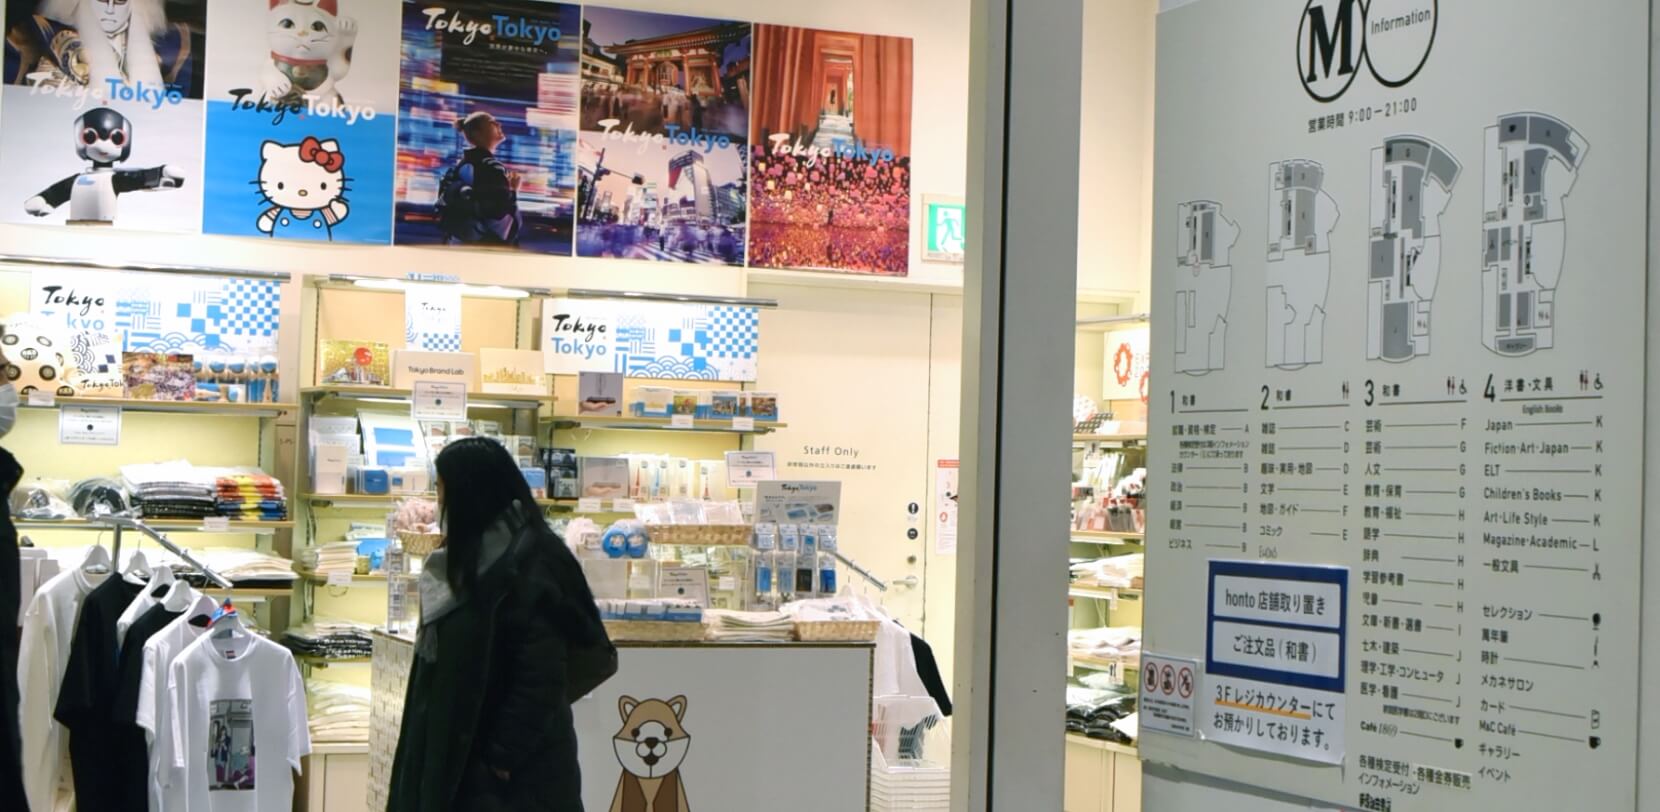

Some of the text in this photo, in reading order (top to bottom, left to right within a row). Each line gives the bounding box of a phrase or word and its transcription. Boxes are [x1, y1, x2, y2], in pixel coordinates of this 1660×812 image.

[422, 8, 561, 45] Tokyo Tokyo
[1371, 9, 1430, 34] Information
[1307, 0, 1354, 83] M
[105, 78, 182, 109] Tokyo
[228, 88, 376, 126] Tokyo Tokyo
[1308, 112, 1344, 133] 営業時間
[598, 118, 730, 155] Tokyo Tokyo
[768, 132, 894, 168] Tokyo Tokyo
[42, 285, 104, 316] Tokyo
[552, 314, 606, 342] Tokyo
[551, 337, 607, 360] Tokyo
[1364, 379, 1374, 407] 3
[1484, 374, 1496, 402] 4
[1170, 390, 1175, 414] 1
[1260, 385, 1270, 410] 2
[1366, 418, 1467, 432] 芸術 F
[1485, 416, 1603, 433] Japan K
[803, 445, 860, 458] Staff Only
[1365, 441, 1466, 454] 芸術 G
[1596, 440, 1603, 453] K
[1365, 462, 1466, 475] 人文 G
[1484, 464, 1602, 476] ELT K
[1260, 483, 1348, 496] 文学 E
[1459, 486, 1465, 498] G
[1484, 487, 1602, 502] Children's Books K
[1459, 509, 1464, 520] H
[1524, 512, 1548, 527] Style
[1593, 514, 1600, 527] K
[1260, 525, 1348, 541] コミック E
[1458, 532, 1464, 544] H
[1593, 537, 1599, 552] L
[1458, 555, 1464, 567] H
[1363, 571, 1464, 590] 学習参考書 H
[1225, 589, 1325, 616] honto 店舗取り置き
[1457, 601, 1463, 613] H
[1483, 604, 1533, 621] セレクション
[1362, 639, 1399, 654] 土木・建築
[1481, 650, 1498, 664] 時計
[1480, 698, 1505, 714] カード
[1214, 712, 1330, 750] お預かりしております。
[1478, 766, 1511, 782] イベント
